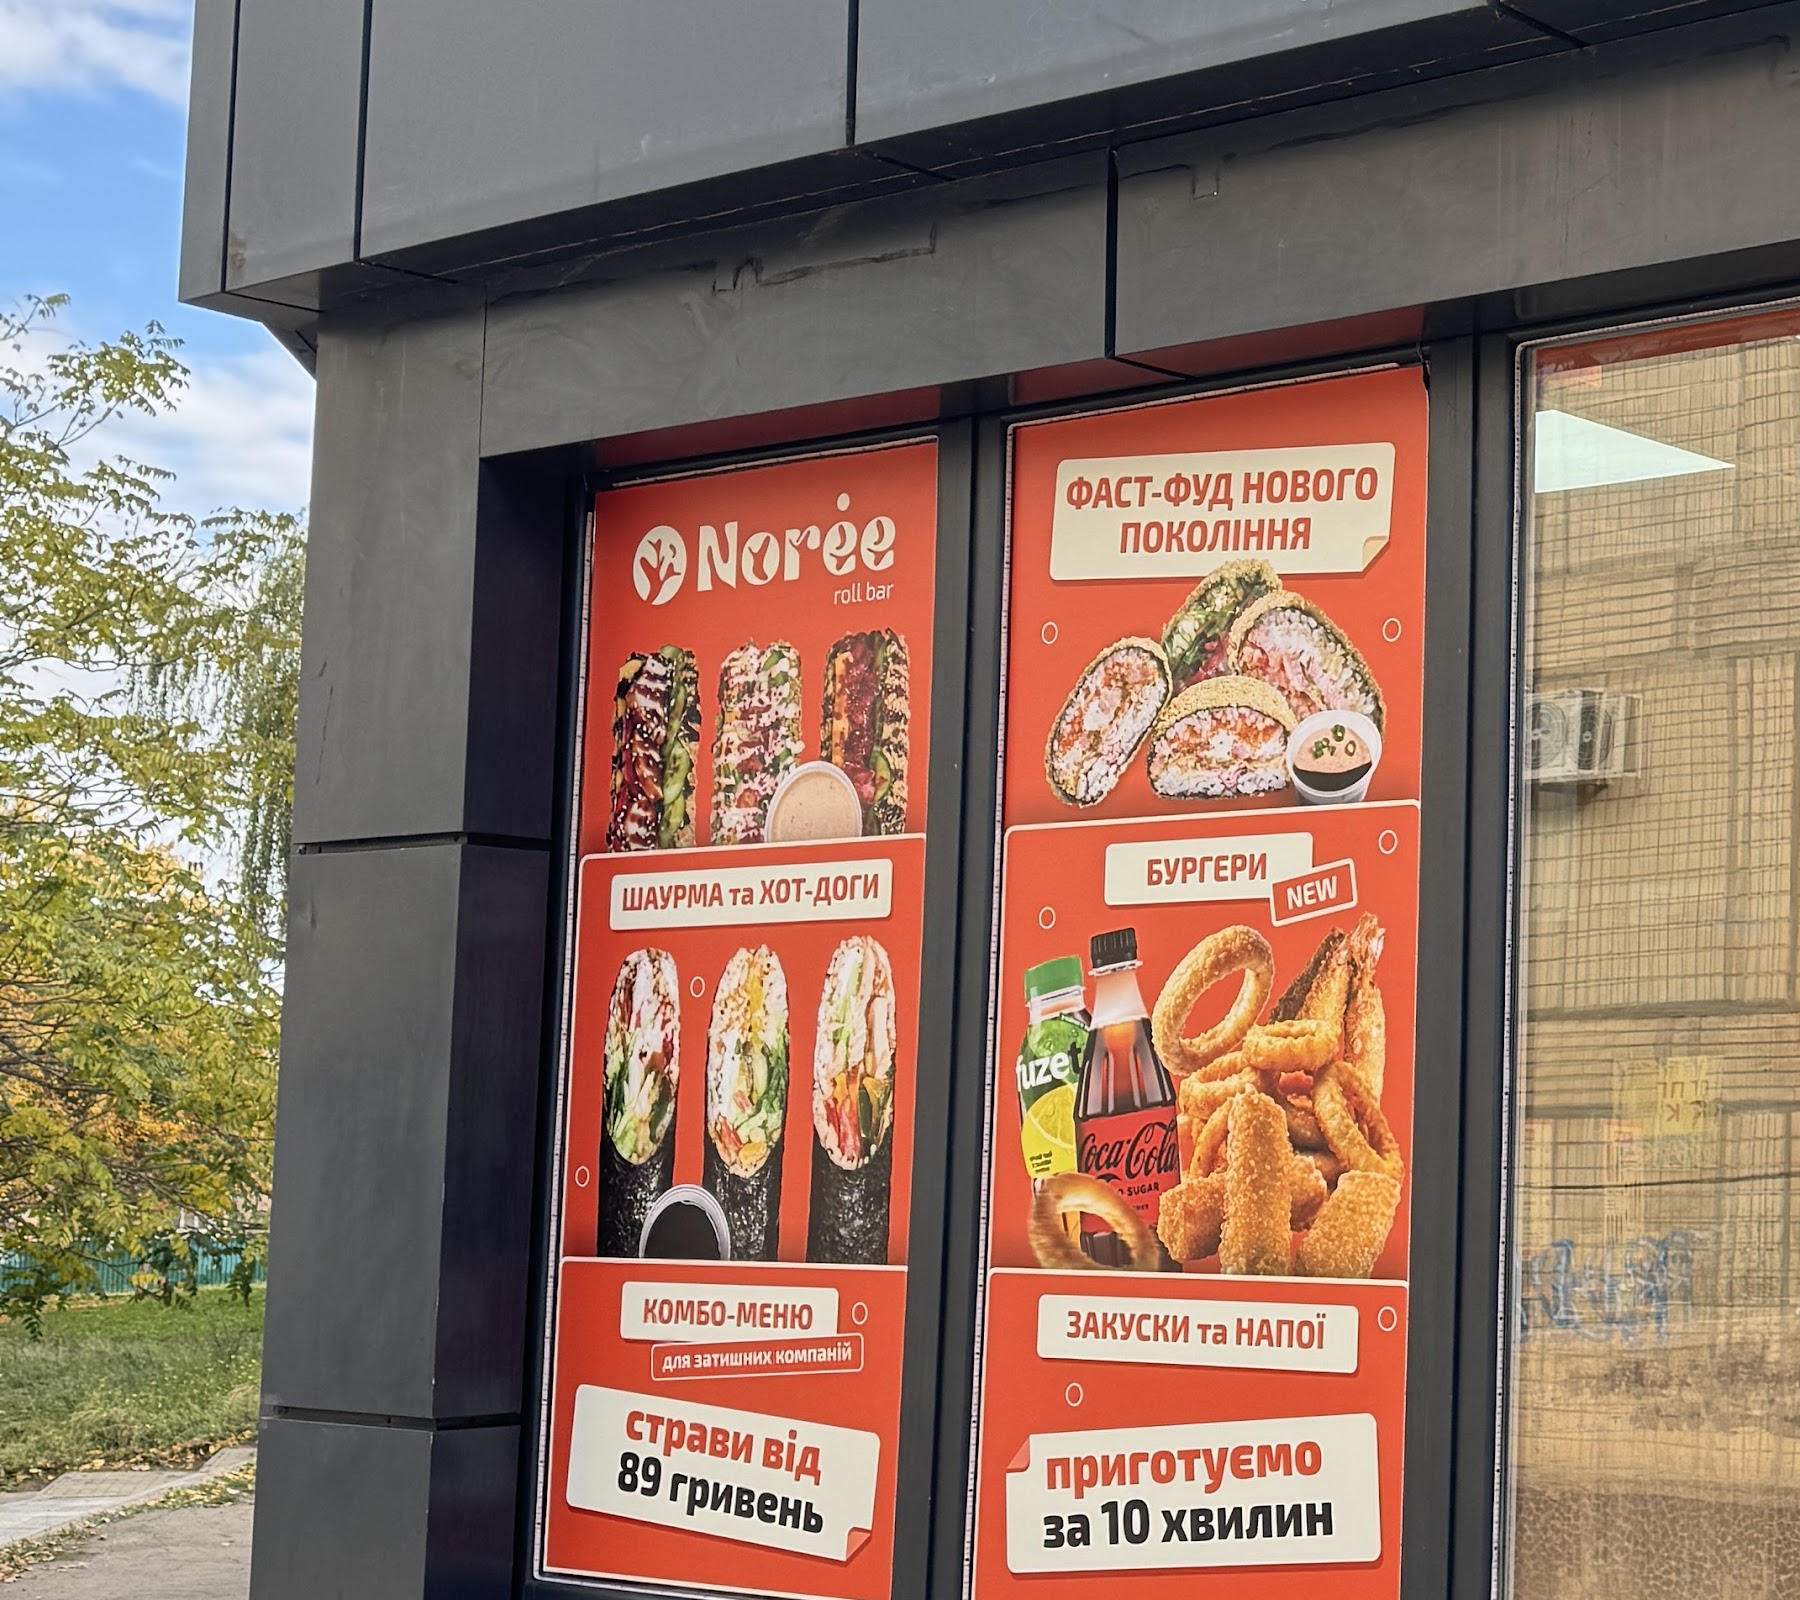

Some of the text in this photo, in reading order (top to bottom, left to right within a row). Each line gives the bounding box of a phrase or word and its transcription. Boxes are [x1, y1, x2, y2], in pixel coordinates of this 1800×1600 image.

[1066, 467, 1379, 513] ФАСТ-ФУД НОВОГО
[1119, 516, 1312, 555] ПОКОЛІННЯ
[833, 580, 894, 605] roll bar
[1146, 854, 1268, 888] БУРГЕРИ
[621, 872, 880, 913] ШАУРМА та ХОТ-ДОГИ
[1286, 875, 1338, 911] NEW
[1081, 1120, 1177, 1180] Coca-Cola
[1127, 1182, 1159, 1196] SUGAR
[643, 1298, 814, 1332] КОМБО-МЕНЮ
[1067, 1311, 1325, 1350] ЗАКУСКИ та НАПОЇ
[661, 1340, 852, 1372] для затишних компаній
[625, 1408, 821, 1486] страви від
[1046, 1438, 1322, 1494] приготуємо
[617, 1452, 824, 1535] 89 гривень
[1043, 1498, 1334, 1549] за 10 хвилин
